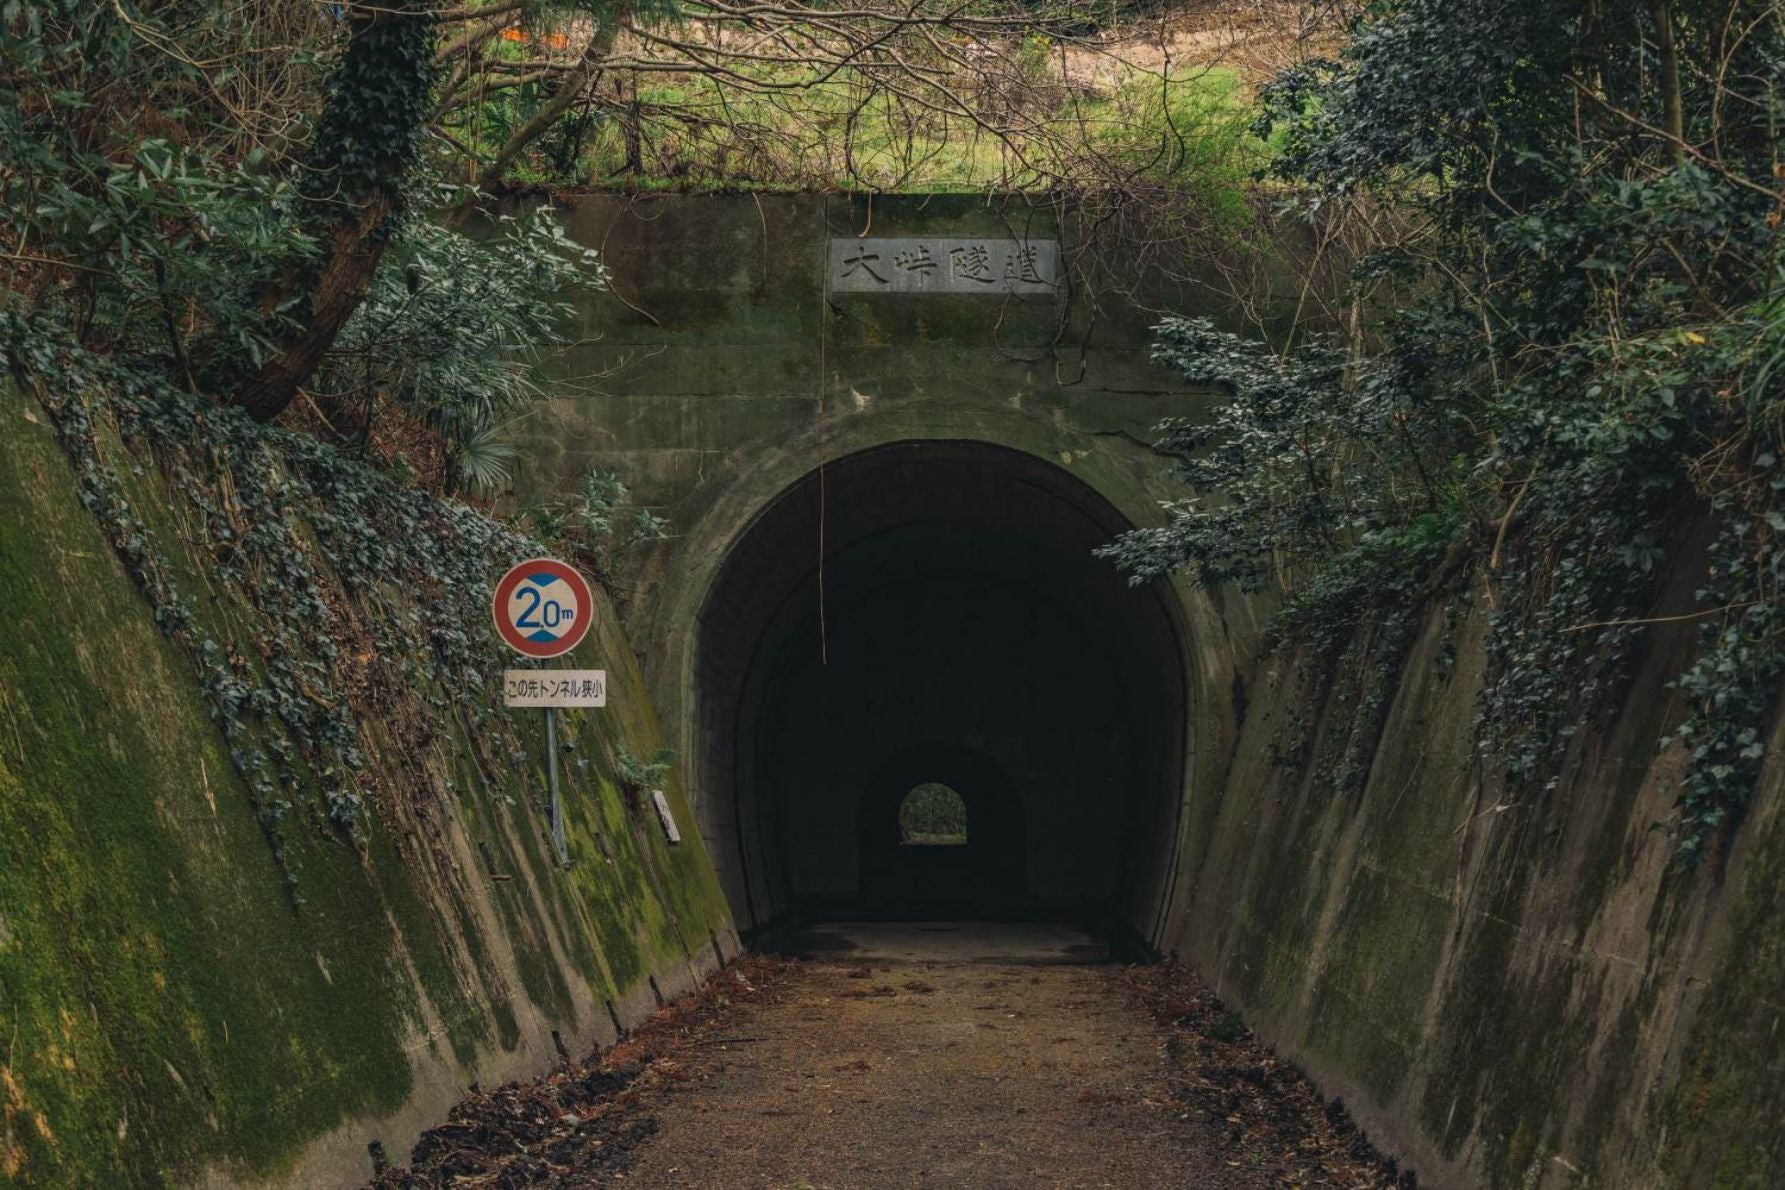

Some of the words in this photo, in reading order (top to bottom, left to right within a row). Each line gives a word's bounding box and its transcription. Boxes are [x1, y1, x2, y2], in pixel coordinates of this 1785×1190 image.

[841, 245, 1042, 286] 大峠隧道
[515, 586, 574, 628] 2.0m
[507, 678, 602, 698] この先トンネル狭小
